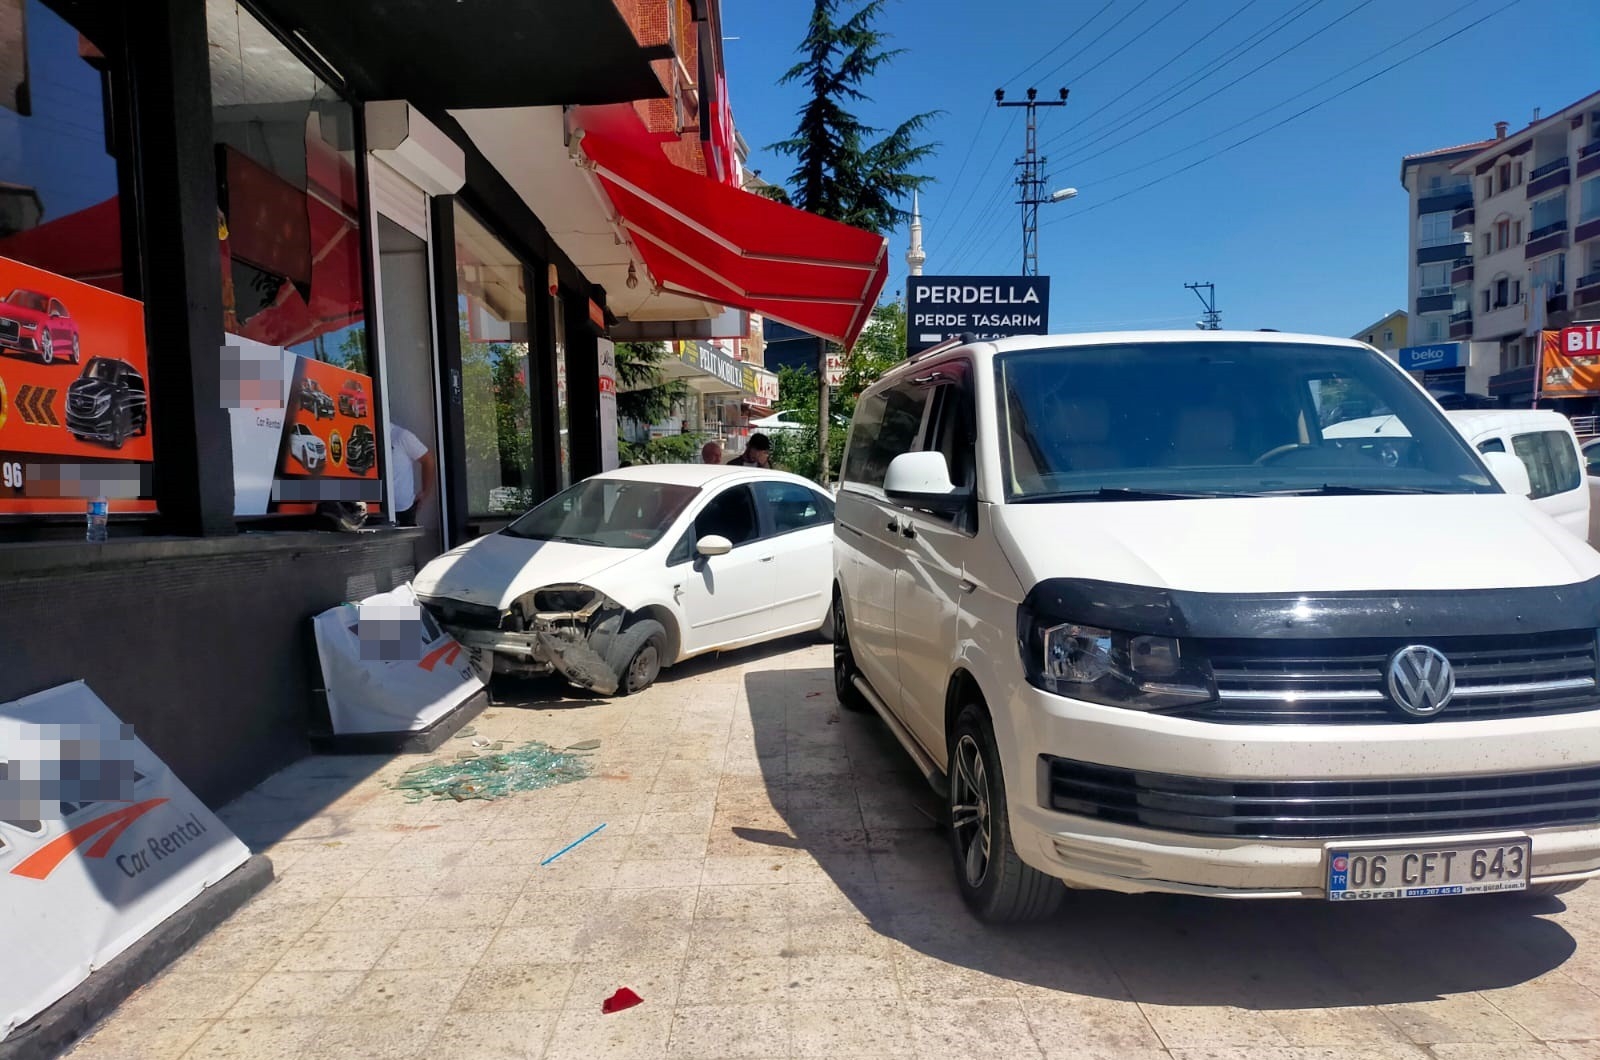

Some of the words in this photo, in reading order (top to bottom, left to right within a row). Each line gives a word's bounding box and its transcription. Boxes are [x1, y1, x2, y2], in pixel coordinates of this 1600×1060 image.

[915, 286, 1040, 304] PERDELLA
[915, 314, 967, 327] PERDE
[972, 314, 1041, 327] TASARIM
[1411, 349, 1444, 361] beko
[2, 462, 23, 488] 96
[115, 847, 151, 878] Car
[146, 812, 208, 861] Rental
[1351, 855, 1388, 886] 06
[1402, 851, 1458, 884] CFT
[1472, 847, 1524, 880] 643
[1332, 875, 1346, 884] TR
[1341, 890, 1402, 900] Göral
